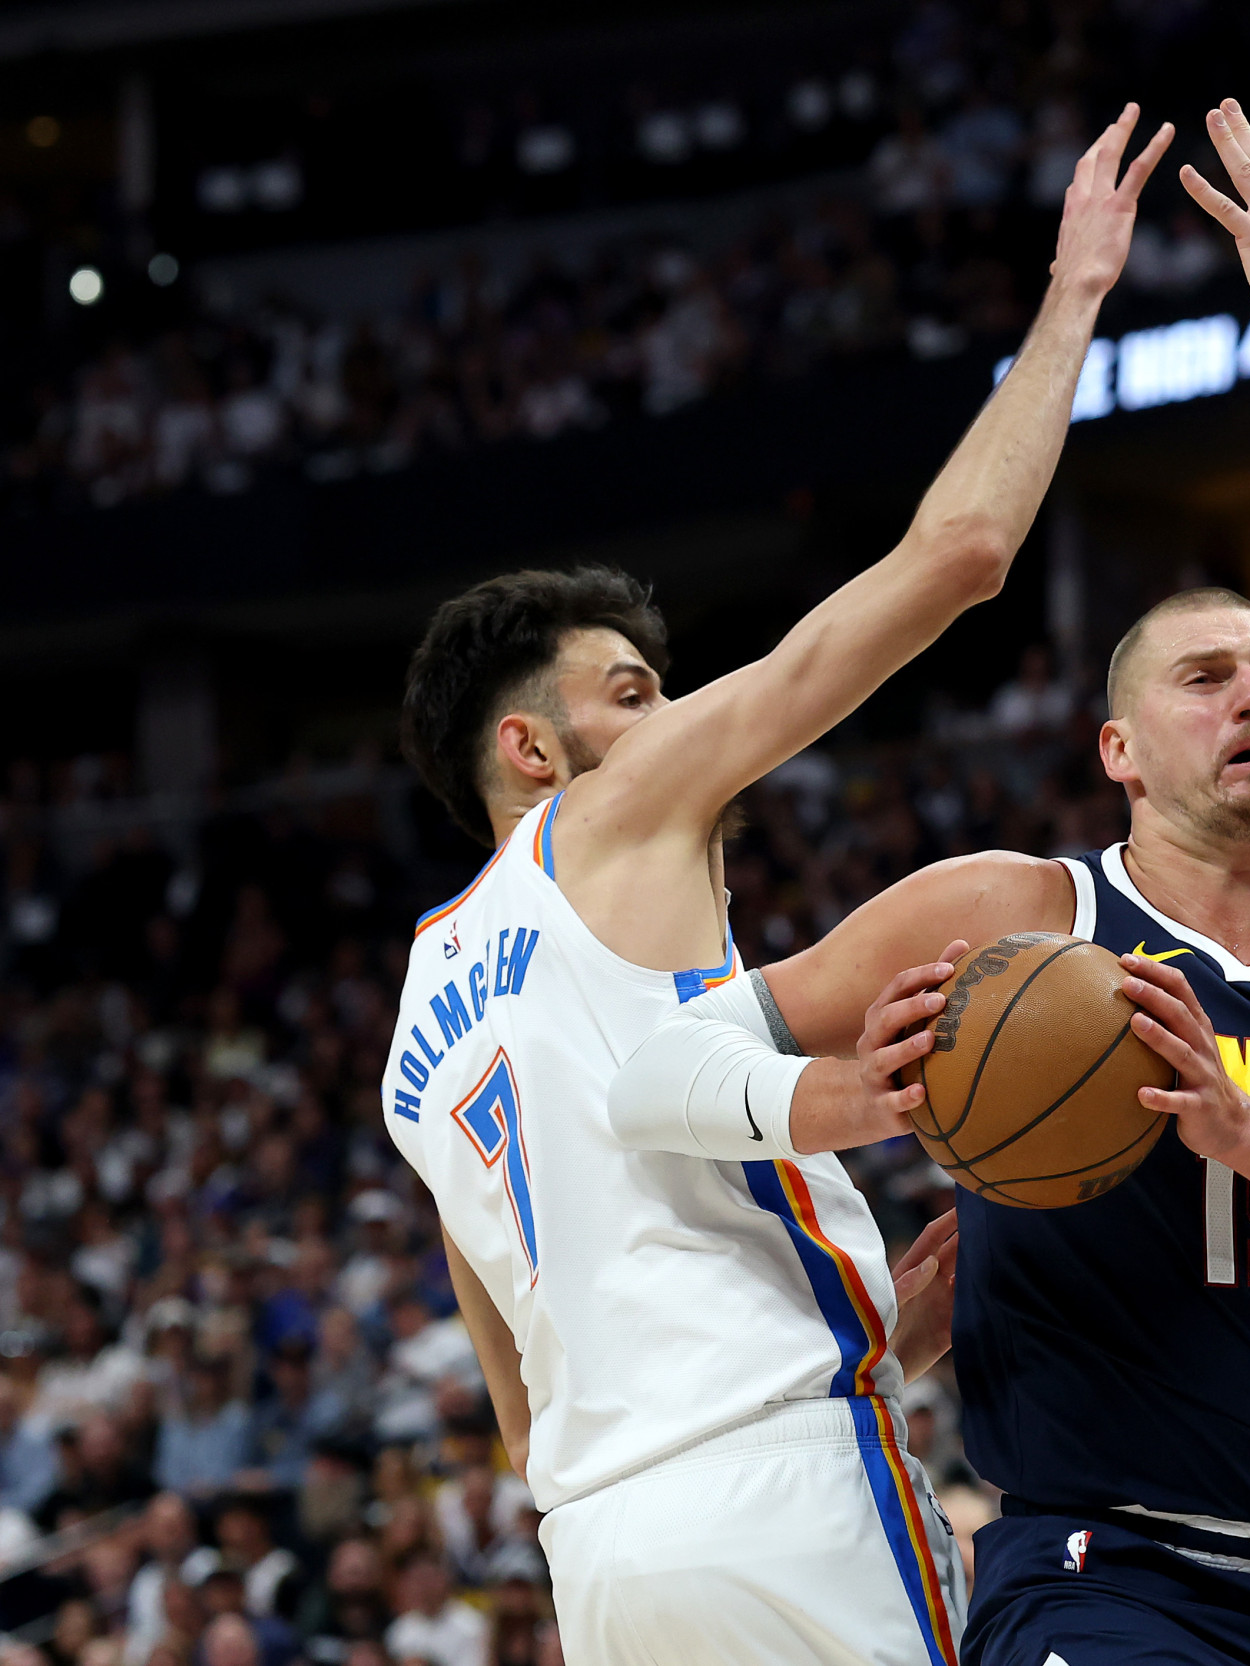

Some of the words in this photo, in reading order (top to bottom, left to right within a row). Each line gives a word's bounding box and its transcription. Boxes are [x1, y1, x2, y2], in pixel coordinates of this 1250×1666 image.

[394, 927, 540, 1123] HOLMGEN
[450, 1046, 539, 1291] 7
[1063, 1559, 1076, 1571] NBA
